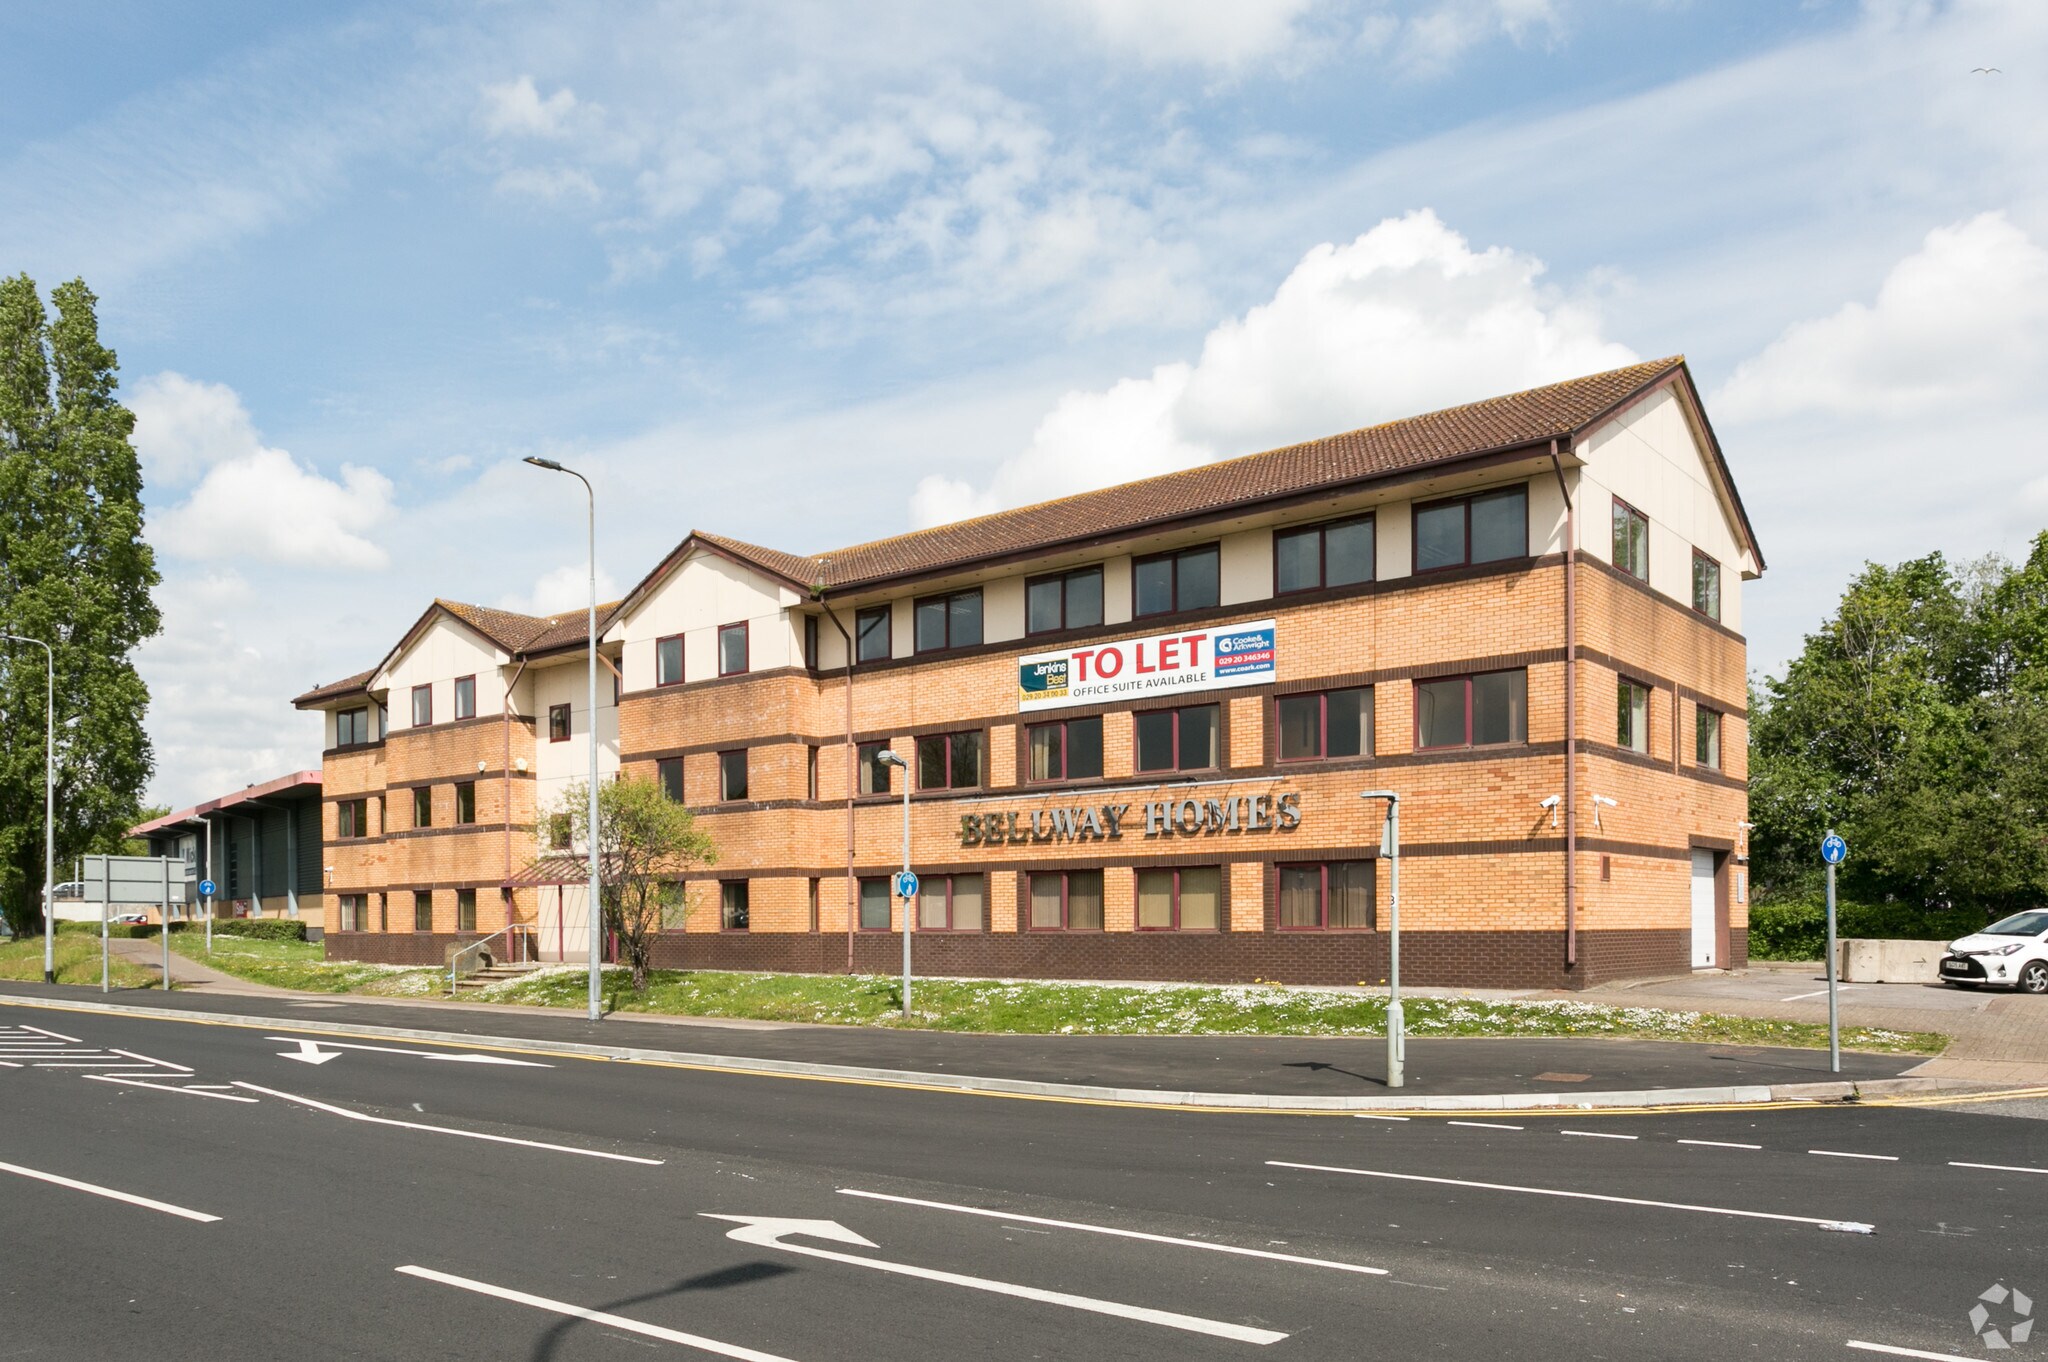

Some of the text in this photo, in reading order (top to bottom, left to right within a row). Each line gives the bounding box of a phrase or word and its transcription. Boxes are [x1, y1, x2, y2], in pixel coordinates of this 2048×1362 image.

[1233, 640, 1270, 651] Arkwright
[1072, 634, 1207, 681] TO LET
[1218, 652, 1270, 665] 029 20 346346
[1034, 662, 1066, 675] Jenkins
[1219, 663, 1271, 674] www.coark.com
[1047, 673, 1066, 685] Best
[1073, 684, 1110, 697] OFFICE
[1112, 680, 1143, 693] SUITE
[1145, 672, 1207, 689] AVAILABLE
[1034, 692, 1042, 700] 20
[961, 792, 1300, 845] BELLWAY HOMES
